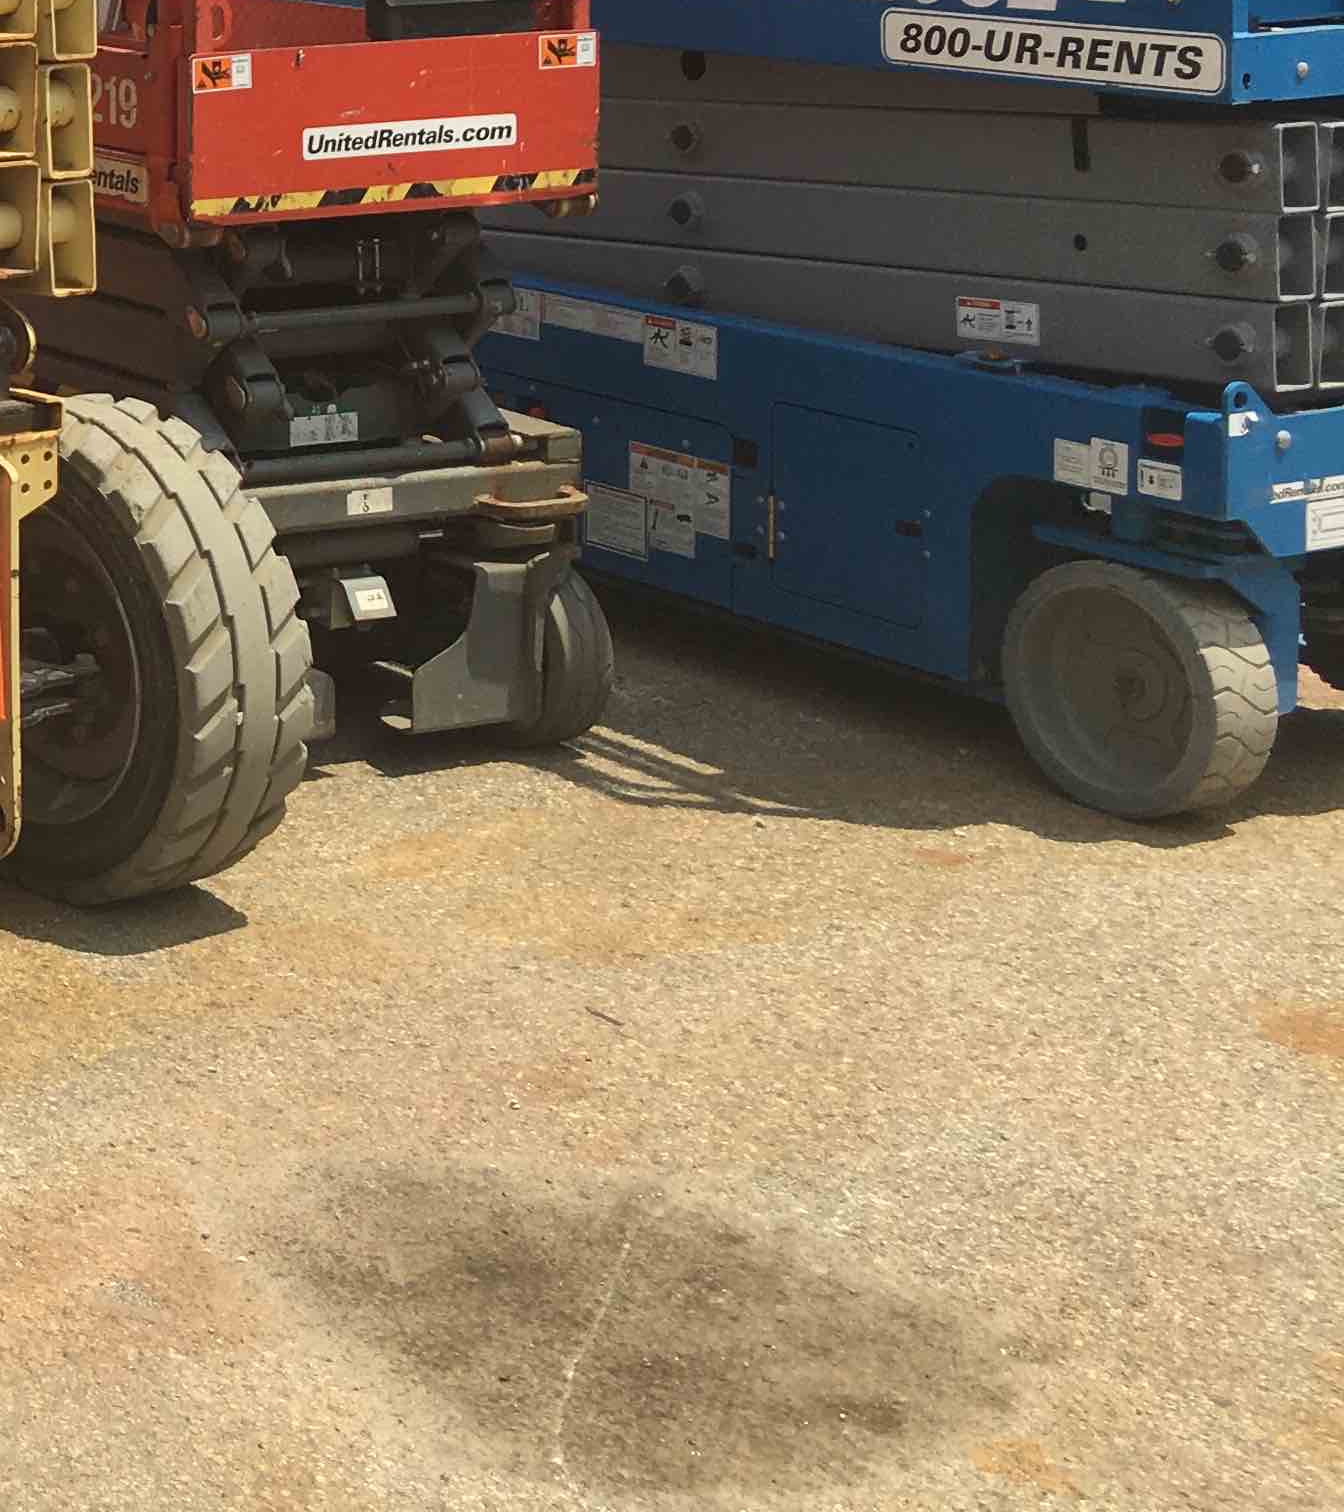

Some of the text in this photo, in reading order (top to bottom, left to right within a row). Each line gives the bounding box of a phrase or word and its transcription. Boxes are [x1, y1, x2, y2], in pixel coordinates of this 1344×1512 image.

[899, 22, 1204, 80] 800-UR-RENTS
[307, 124, 512, 154] UnitedRentals.com
[91, 169, 140, 195] entals
